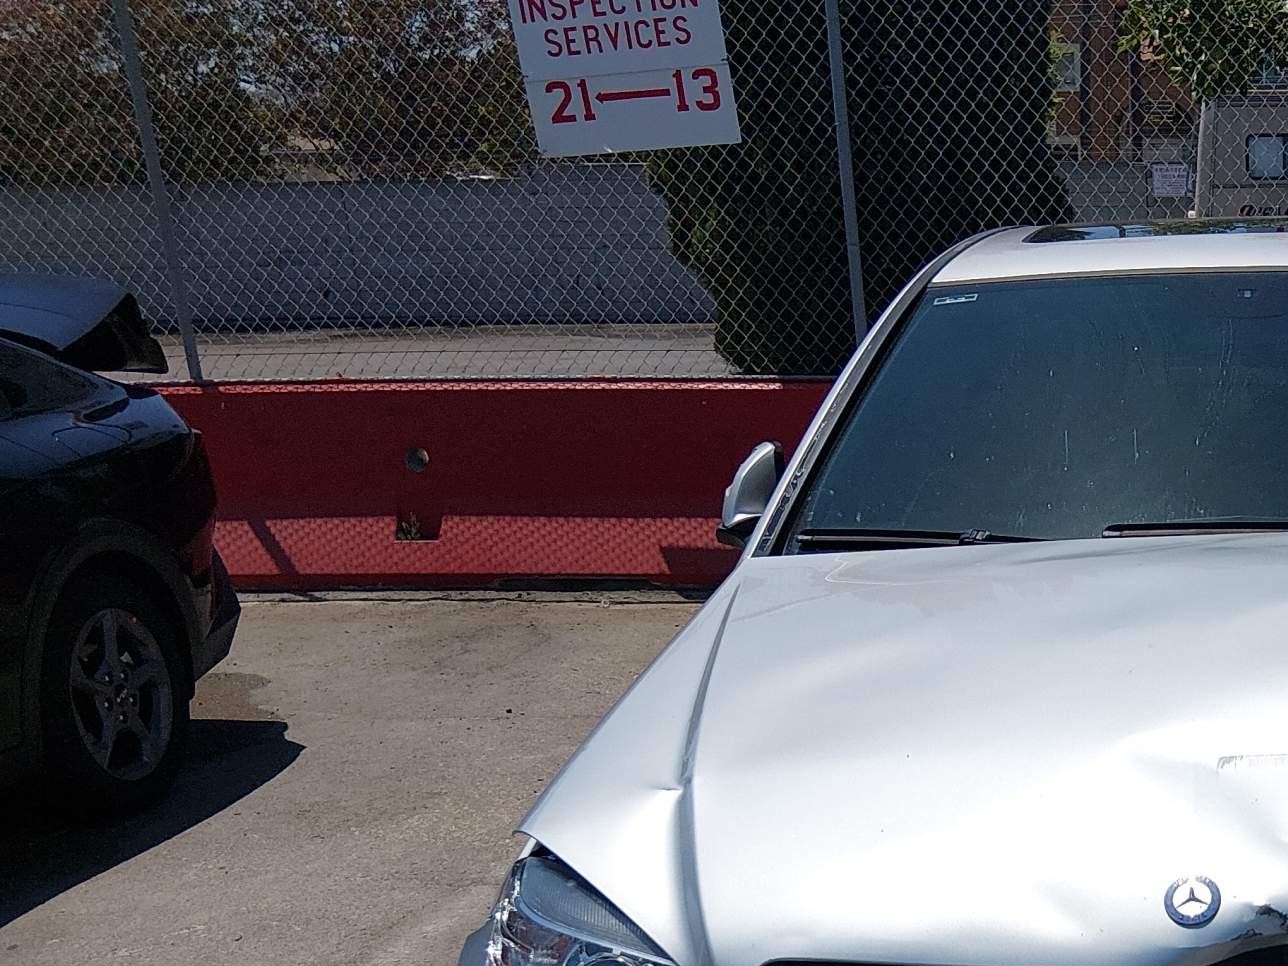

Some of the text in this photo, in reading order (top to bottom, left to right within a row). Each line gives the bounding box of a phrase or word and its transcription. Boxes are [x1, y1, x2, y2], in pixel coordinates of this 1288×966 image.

[519, 0, 699, 24] INSPEC
[544, 15, 692, 57] SERVICES
[545, 67, 721, 124] 21 13
